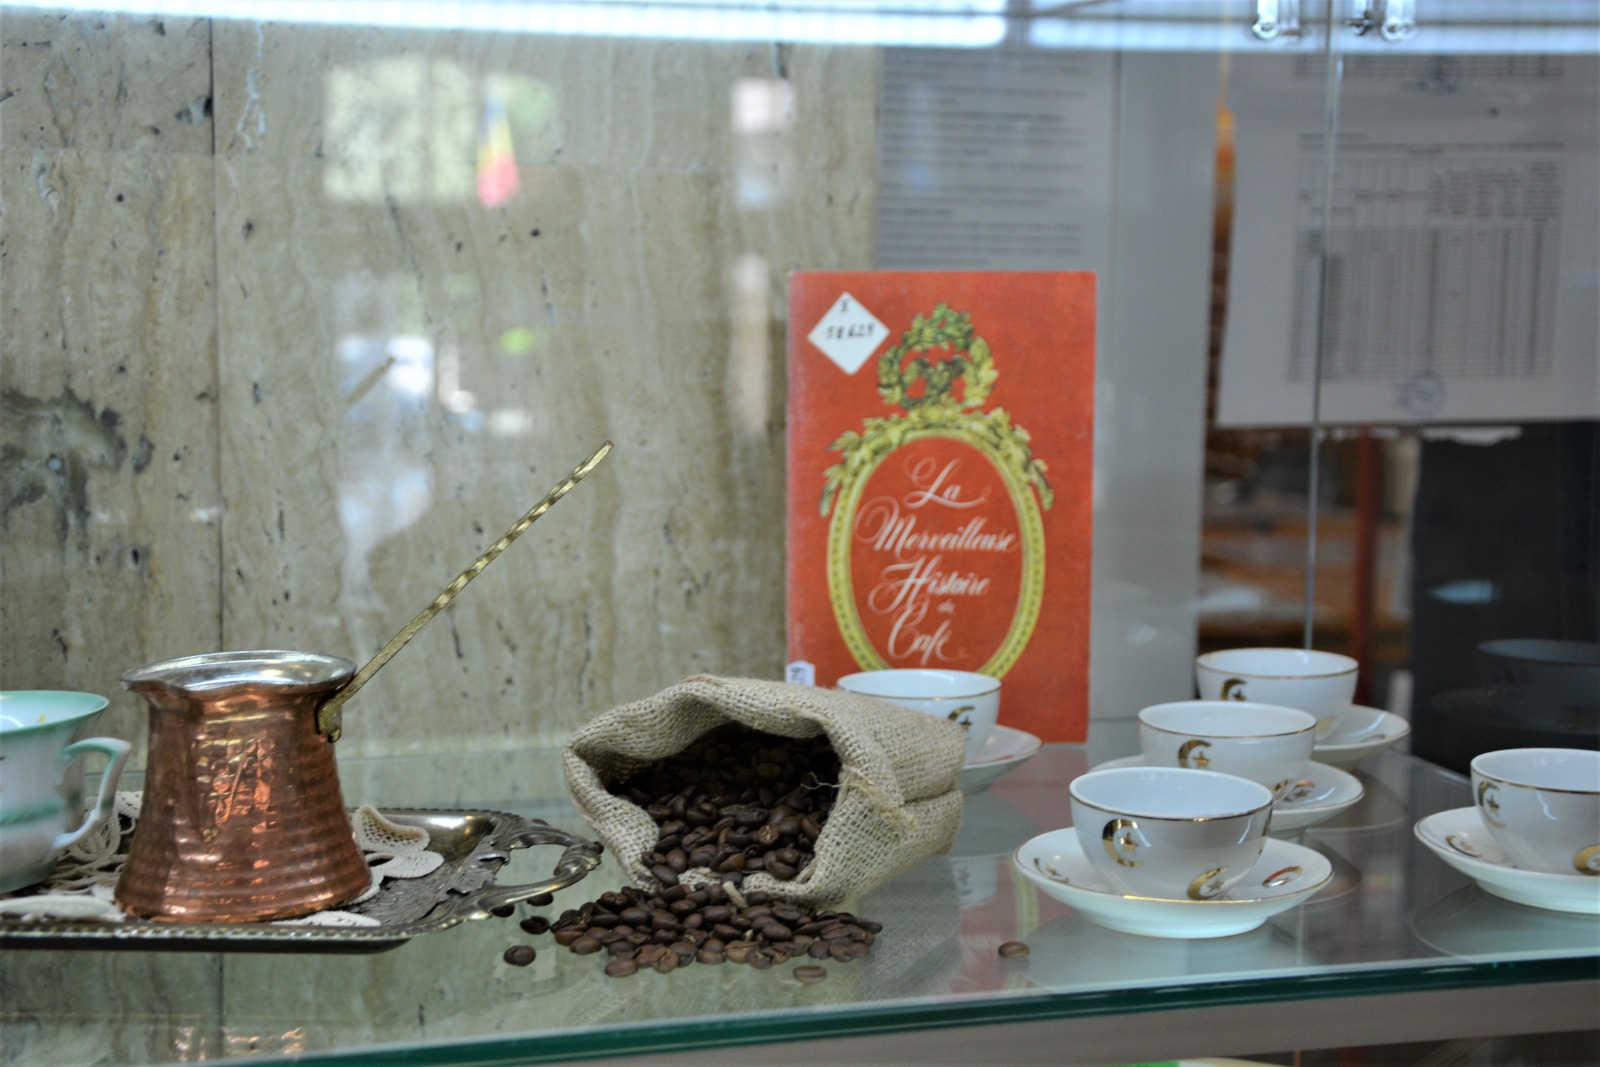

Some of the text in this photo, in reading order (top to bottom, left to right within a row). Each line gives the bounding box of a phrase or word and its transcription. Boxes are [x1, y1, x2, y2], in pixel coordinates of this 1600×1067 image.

[903, 455, 991, 509] La
[856, 497, 1016, 560] Merveilleuse
[868, 555, 990, 615] Histoire
[888, 606, 966, 666] Café
